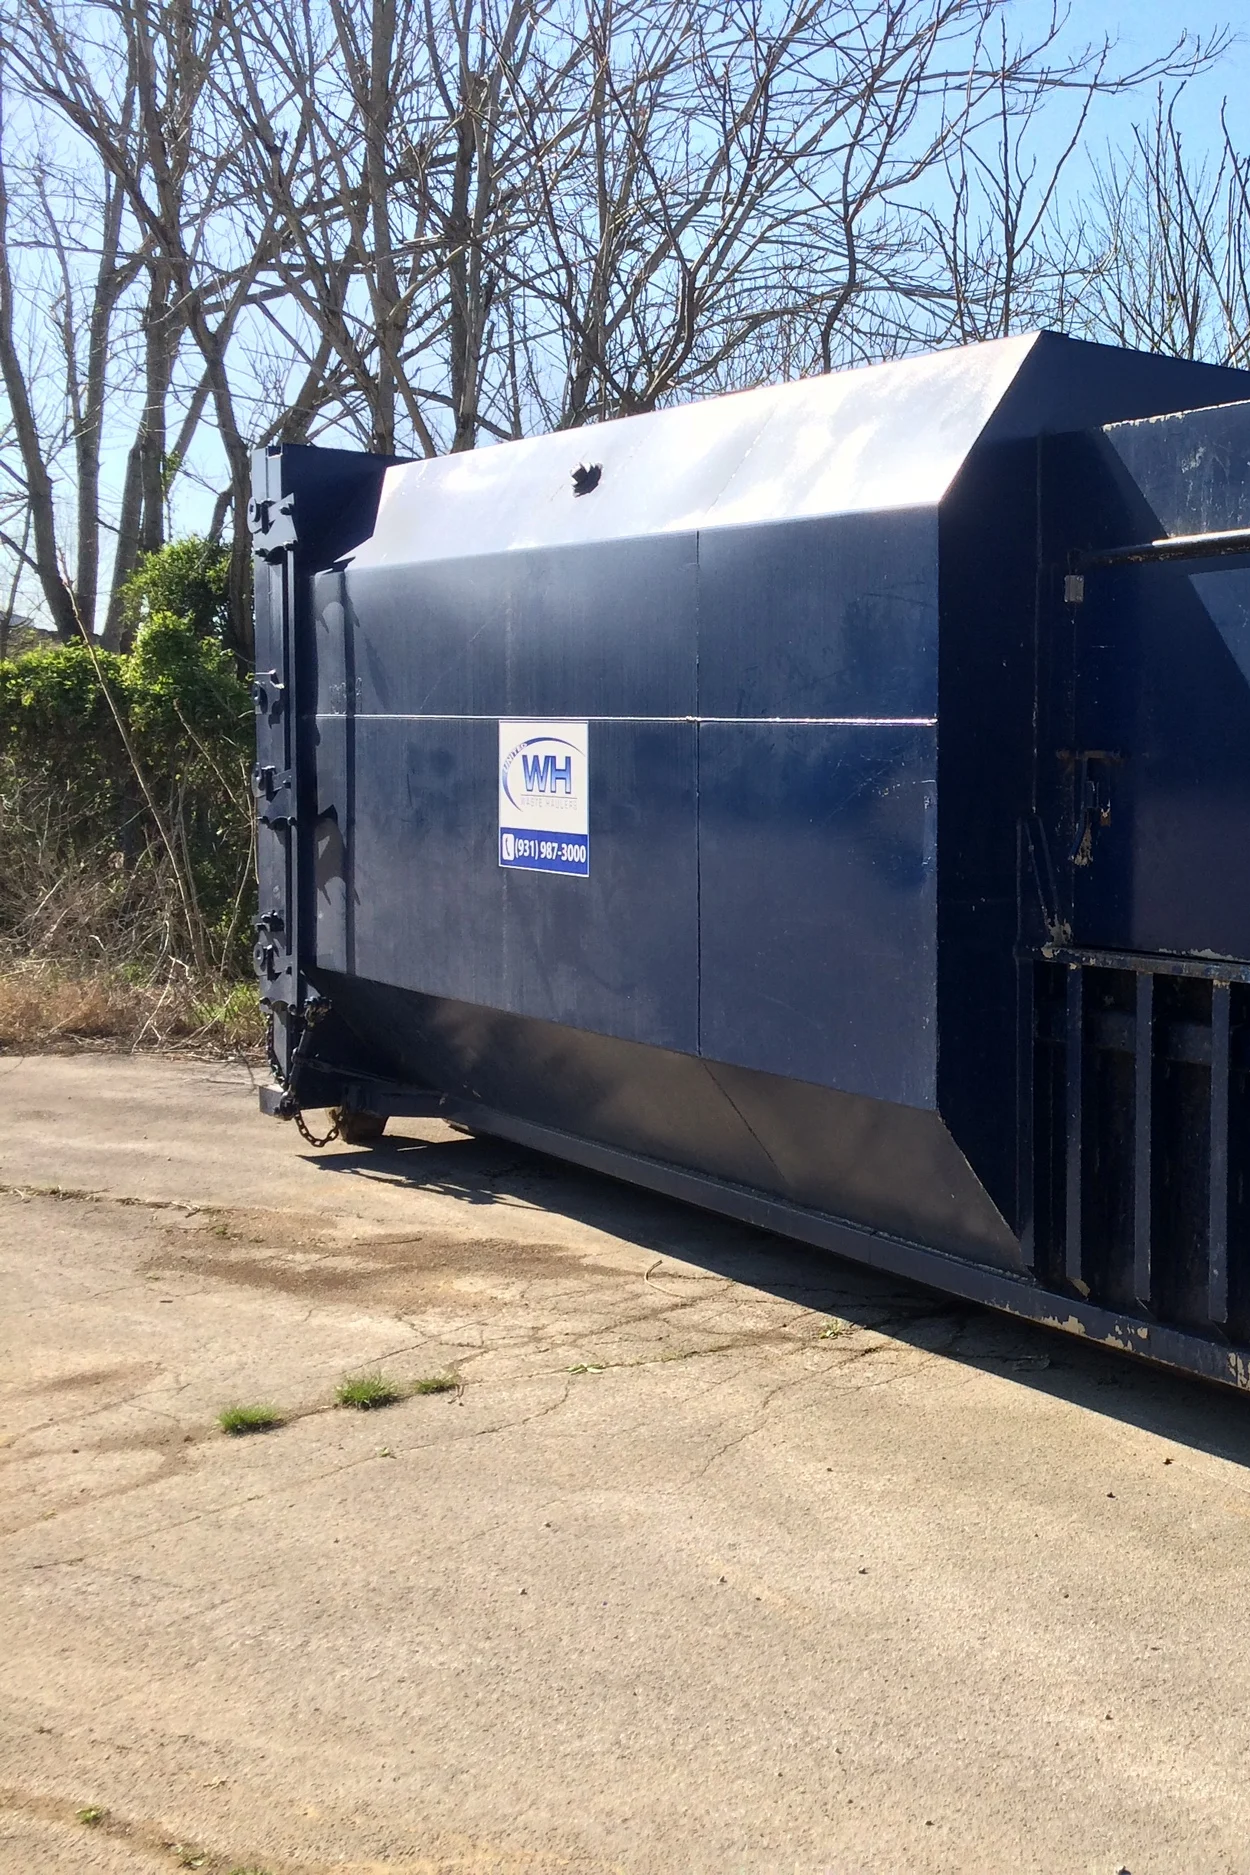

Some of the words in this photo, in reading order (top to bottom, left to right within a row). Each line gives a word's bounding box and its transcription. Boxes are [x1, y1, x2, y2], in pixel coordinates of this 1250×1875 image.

[522, 754, 572, 795] WH
[515, 838, 539, 860] (931)
[540, 842, 587, 864] 987-3000
